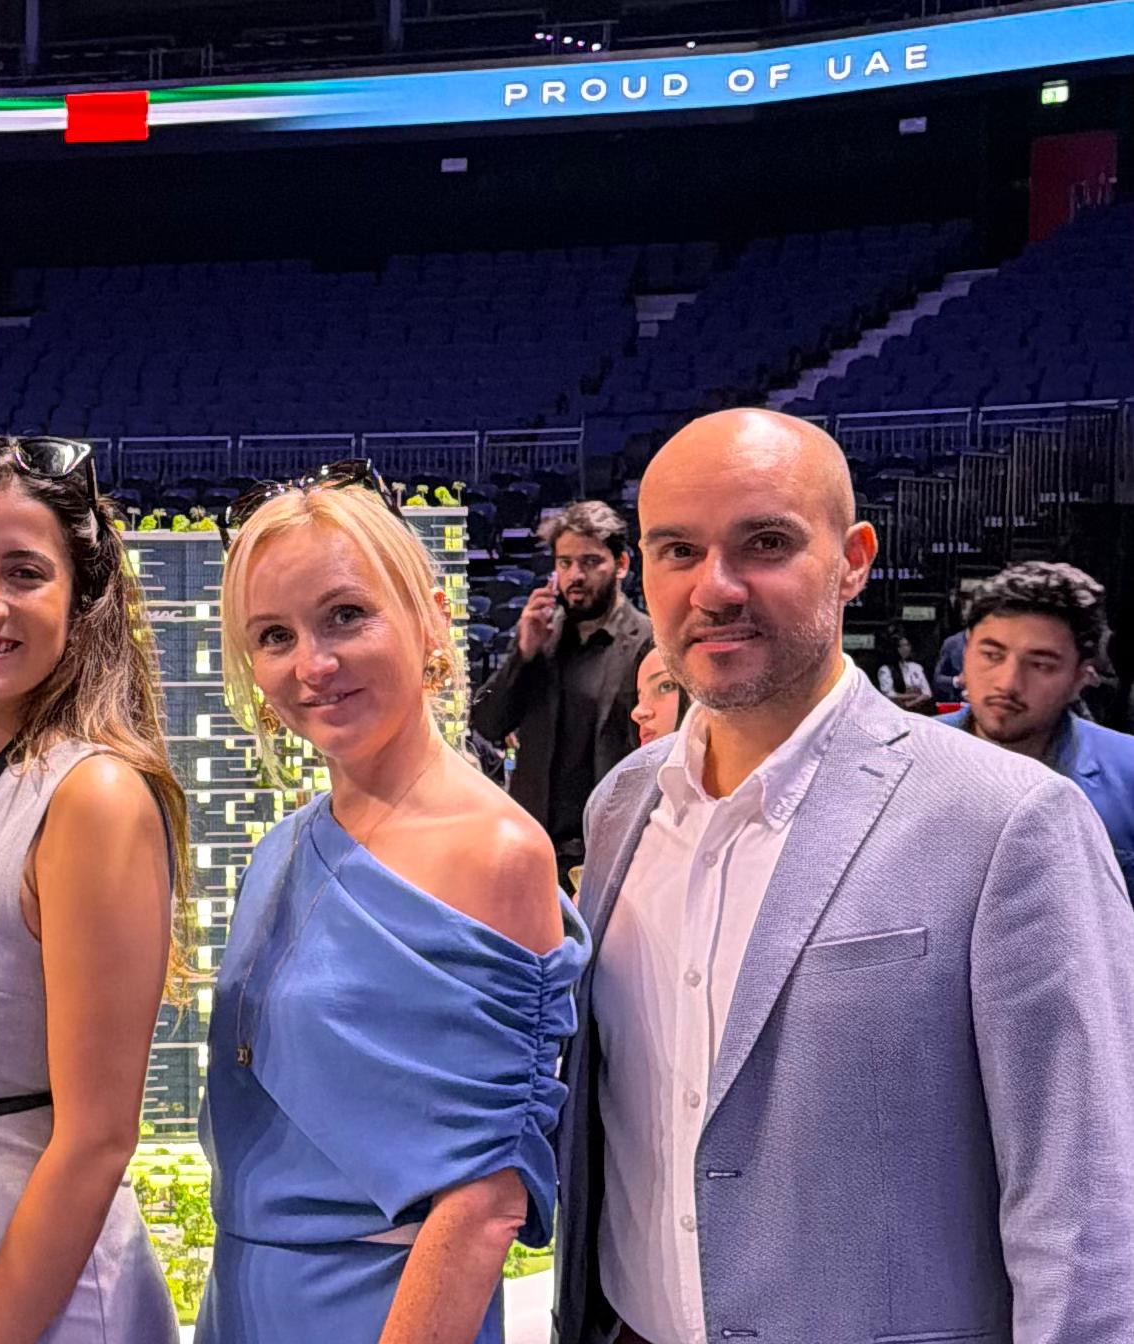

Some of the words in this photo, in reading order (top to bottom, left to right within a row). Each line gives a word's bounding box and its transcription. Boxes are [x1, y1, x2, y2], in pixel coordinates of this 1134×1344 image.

[504, 73, 688, 107] PROUD
[727, 63, 791, 93] OF
[828, 44, 927, 81] UAE
